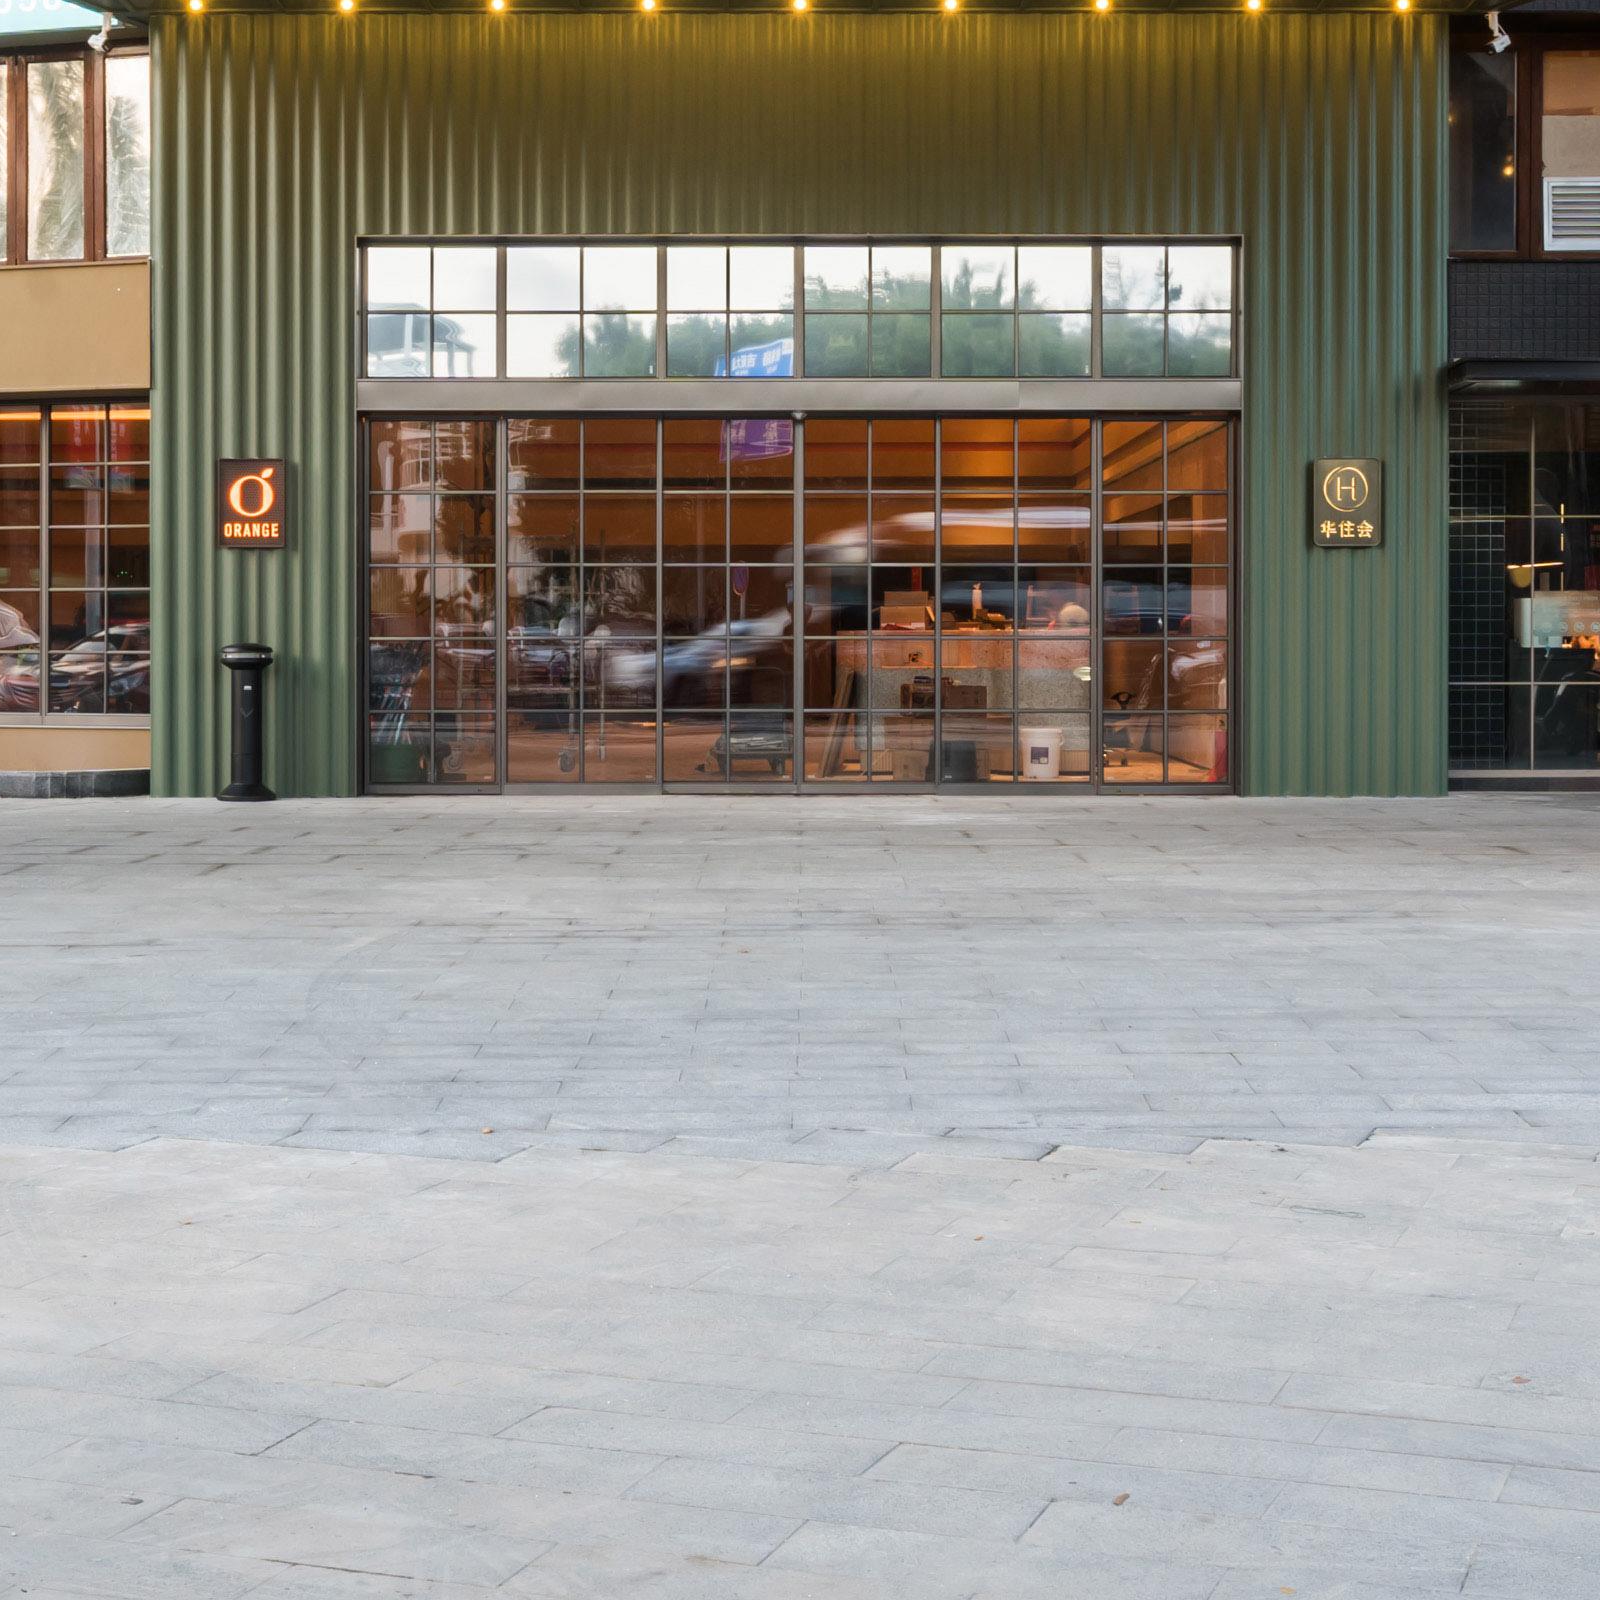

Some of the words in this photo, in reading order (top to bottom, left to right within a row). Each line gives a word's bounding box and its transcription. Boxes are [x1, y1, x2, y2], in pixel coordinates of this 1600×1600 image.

[223, 522, 280, 538] ORANGE
[1319, 519, 1375, 539] 华住会
